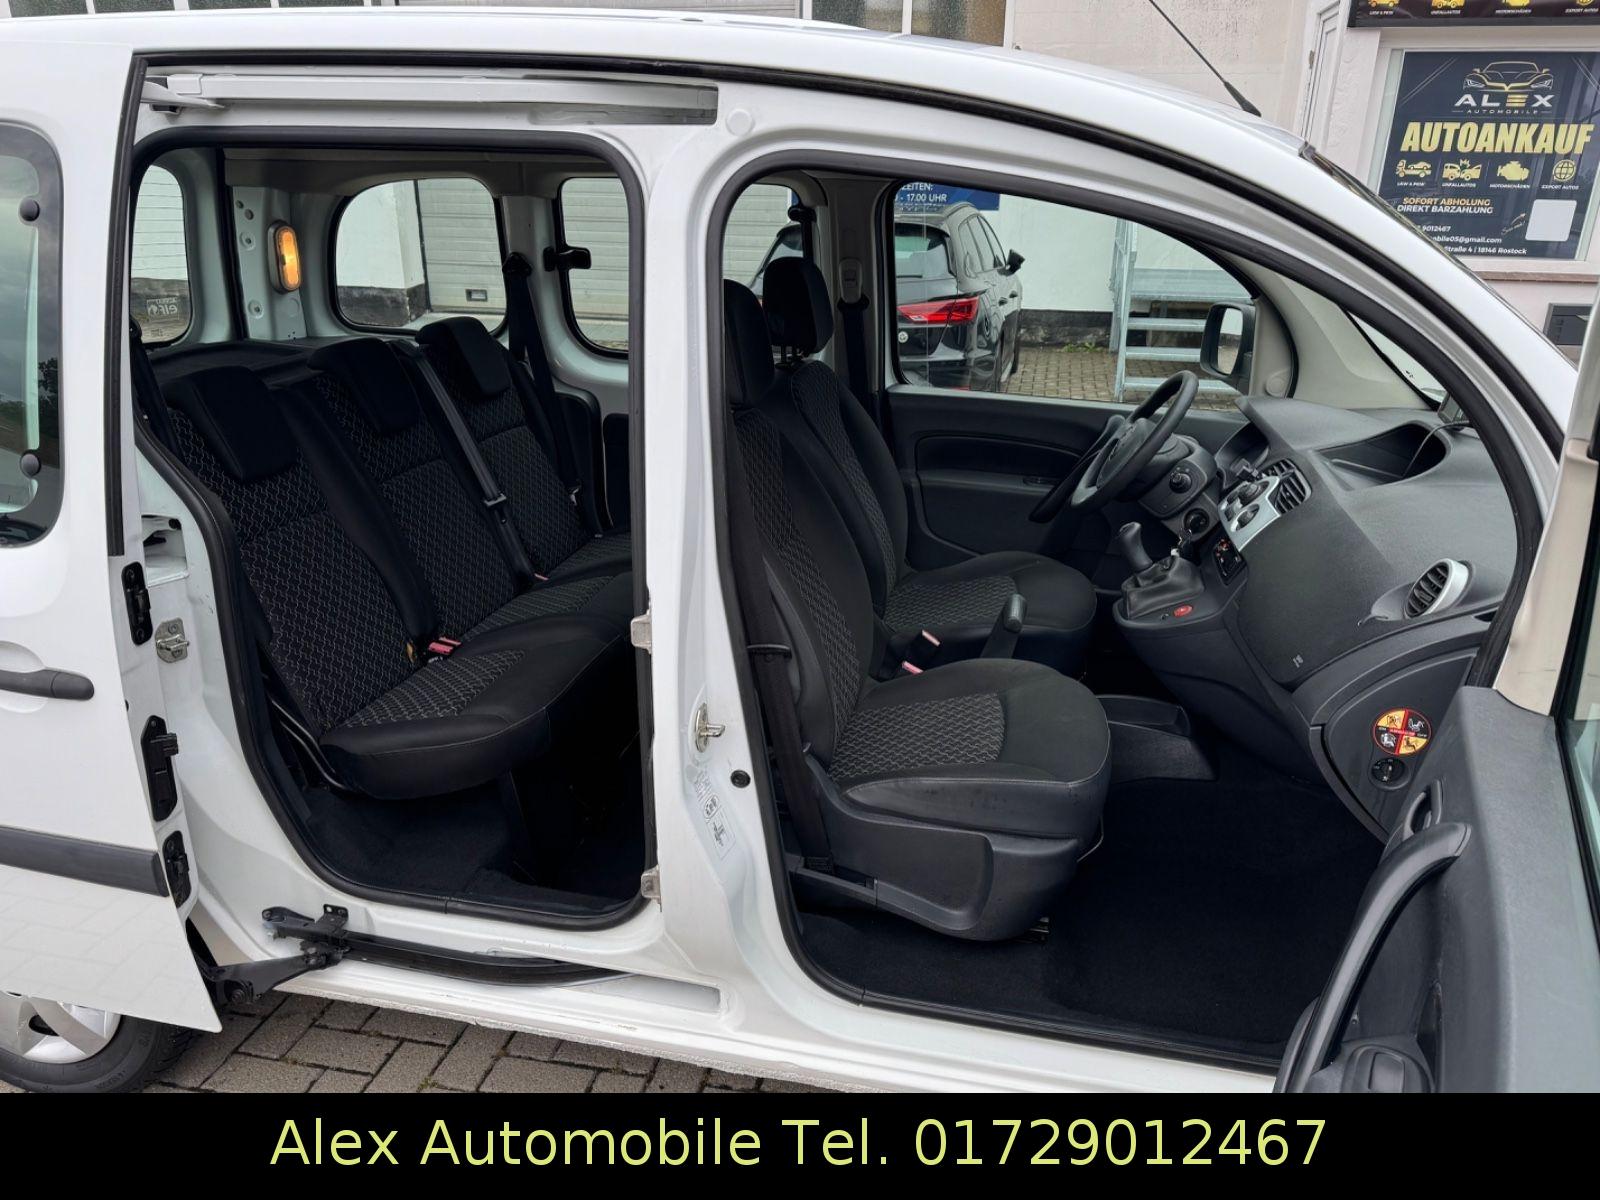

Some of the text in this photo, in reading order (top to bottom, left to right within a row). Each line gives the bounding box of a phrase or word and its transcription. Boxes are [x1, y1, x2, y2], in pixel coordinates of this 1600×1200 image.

[1454, 93, 1555, 107] ALEX
[1401, 121, 1595, 155] AUTOANKAUF
[928, 193, 948, 202] UHR
[1403, 197, 1491, 206] SOFORT ABHOLUNG
[1397, 204, 1494, 214] DIREKT BARZAHLUNG
[1497, 247, 1528, 255] Rostock
